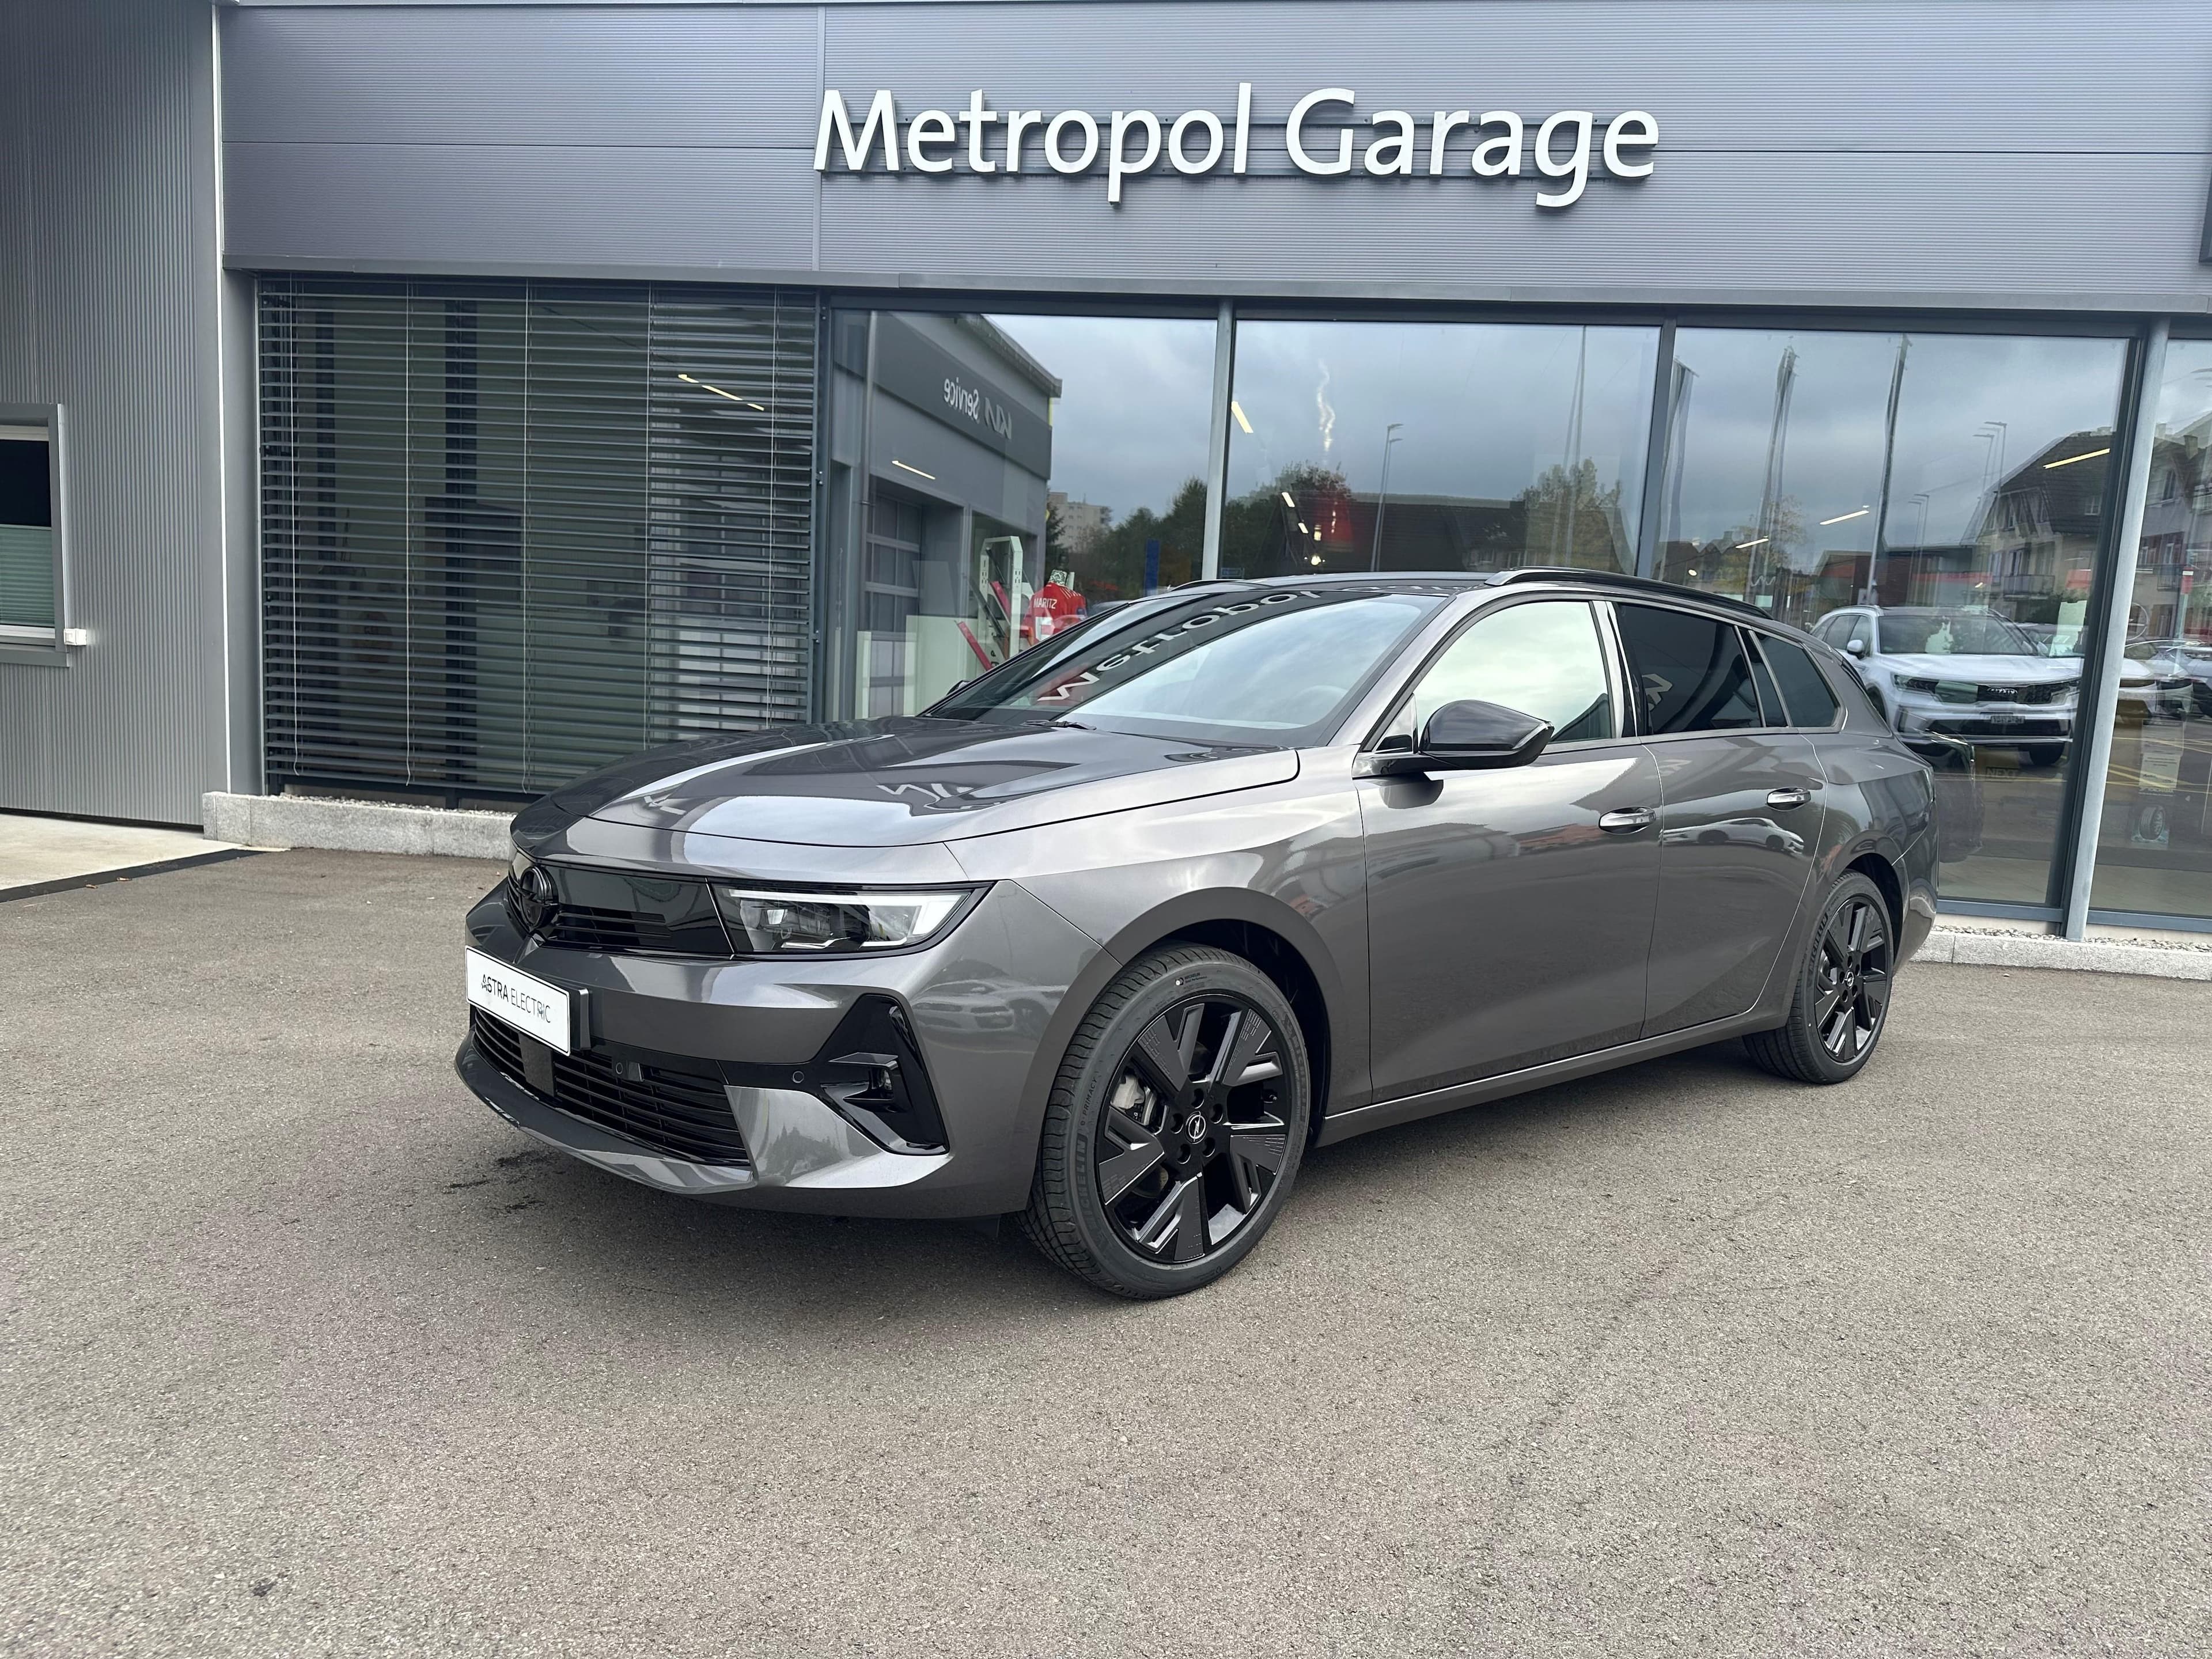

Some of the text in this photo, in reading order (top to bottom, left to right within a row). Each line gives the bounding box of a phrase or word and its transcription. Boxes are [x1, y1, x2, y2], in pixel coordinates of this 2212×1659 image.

[813, 82, 1660, 210] Metropol Garage
[1033, 597, 1058, 609] MARITZ
[480, 974, 551, 1023] ASTRA ELECTRIC
[1082, 1078, 1098, 1116] PRIMACY
